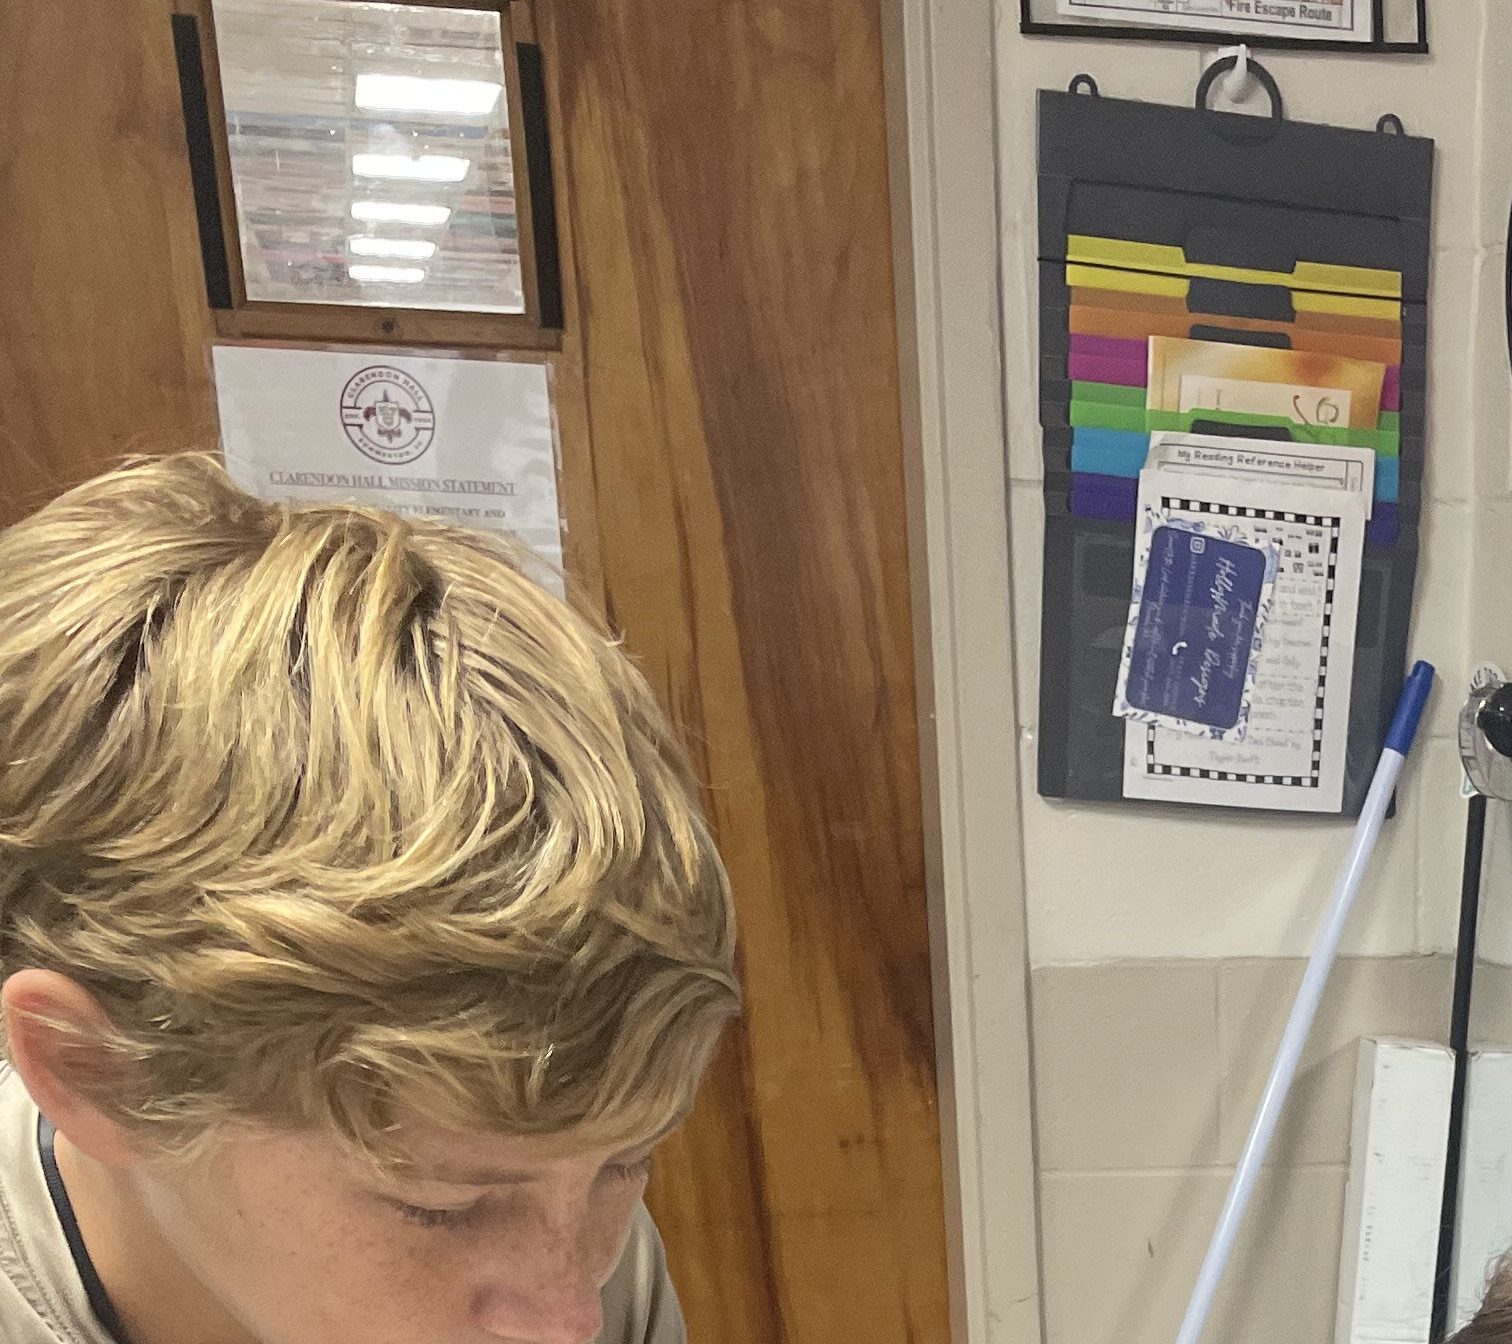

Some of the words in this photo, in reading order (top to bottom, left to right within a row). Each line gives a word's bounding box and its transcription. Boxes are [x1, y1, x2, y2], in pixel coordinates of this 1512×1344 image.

[1229, 0, 1251, 12] Fire
[1254, 1, 1296, 19] Escape
[1299, 6, 1332, 21] Route
[1177, 449, 1191, 462] My
[1194, 449, 1233, 466] Reading
[1238, 454, 1291, 469] Reference
[270, 472, 351, 487] CLARENDON
[353, 475, 386, 489] HALL
[389, 476, 440, 491] MISSION
[442, 480, 515, 495] STATEMENT
